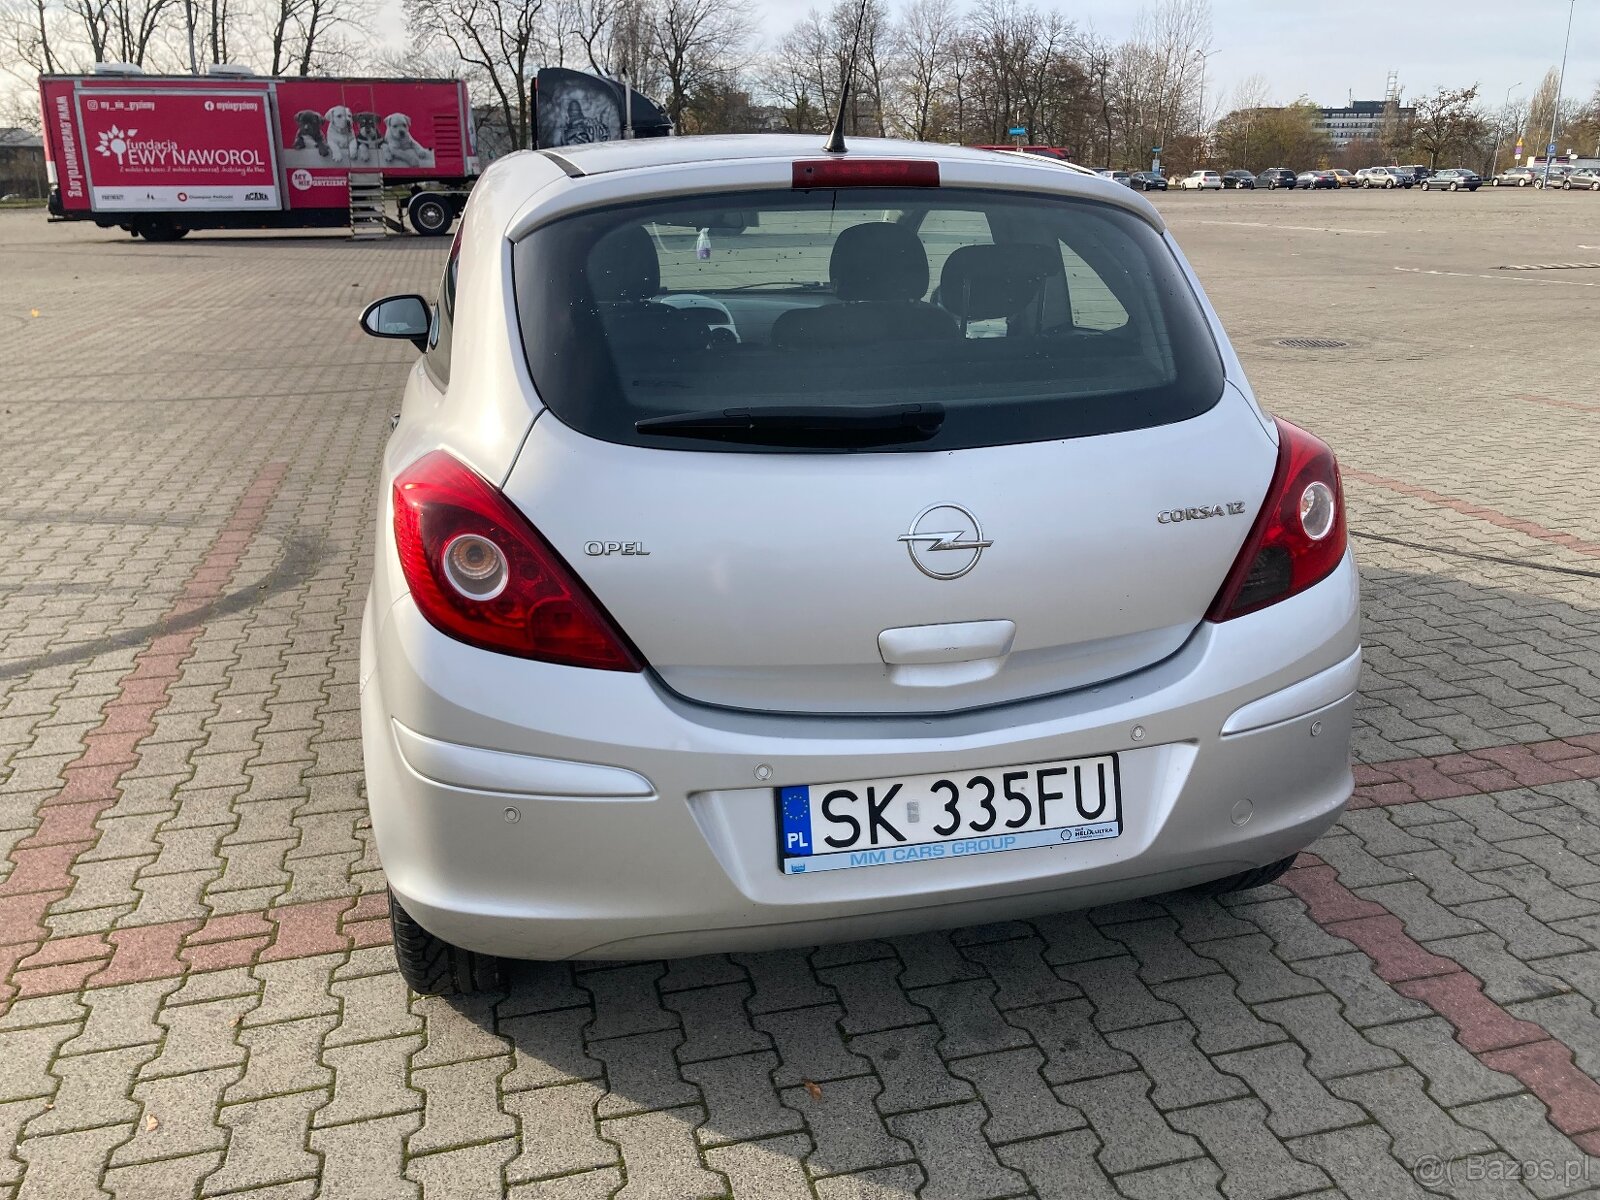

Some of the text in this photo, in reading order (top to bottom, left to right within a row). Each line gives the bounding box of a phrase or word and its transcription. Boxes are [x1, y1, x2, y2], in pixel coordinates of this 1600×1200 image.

[127, 139, 178, 153] fundacja
[128, 149, 265, 165] EWY NAWOROL
[1157, 504, 1225, 524] CORSA
[584, 540, 652, 557] OPEL
[821, 762, 1108, 848] SK 335FU
[787, 832, 808, 849] PL
[850, 836, 1017, 867] MM CARS GROUP
